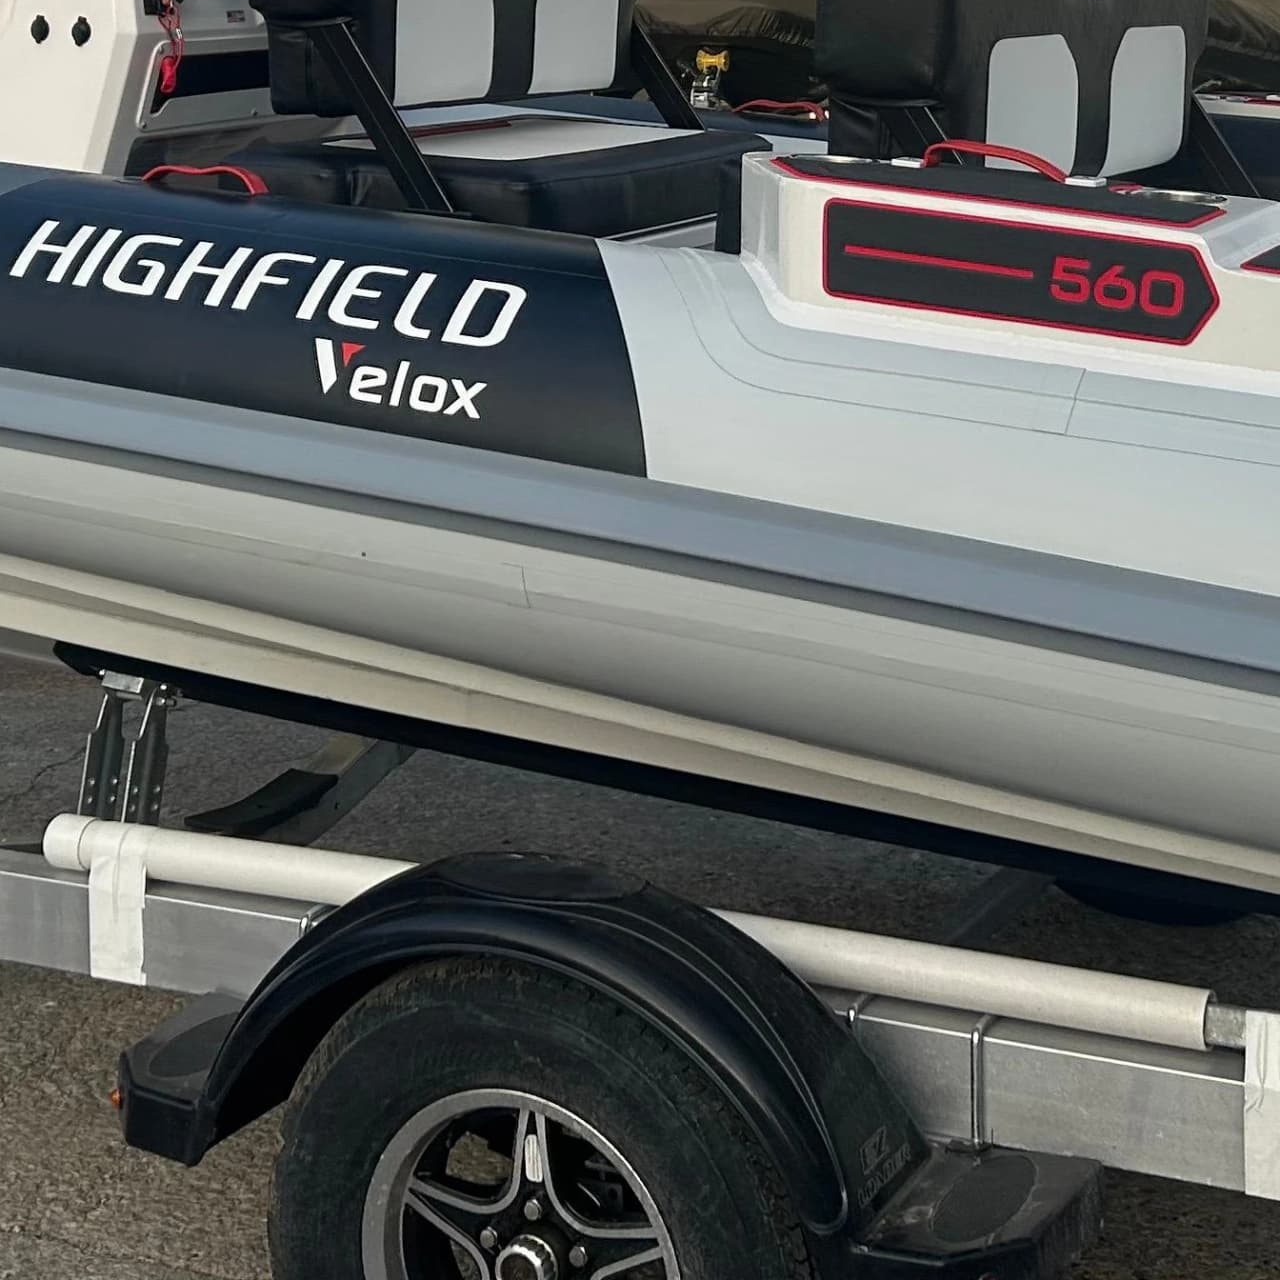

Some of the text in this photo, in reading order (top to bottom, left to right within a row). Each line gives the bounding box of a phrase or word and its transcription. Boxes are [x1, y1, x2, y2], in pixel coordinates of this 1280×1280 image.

[9, 219, 528, 348] HIGHFIELD
[1048, 255, 1186, 318] 560
[315, 337, 488, 420] Velox
